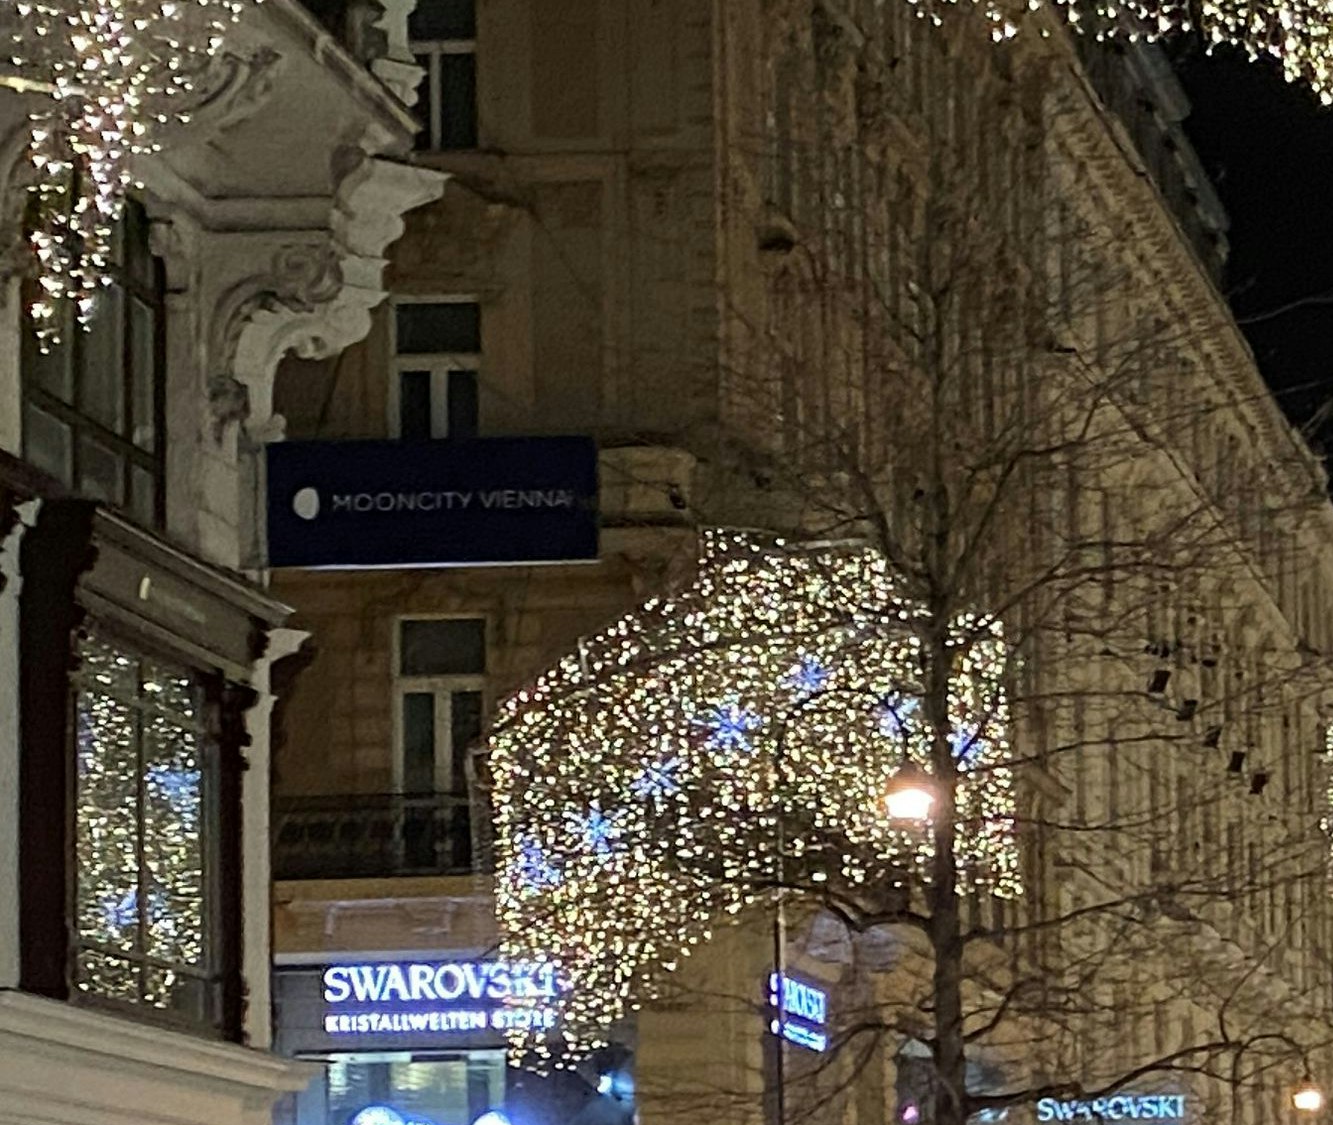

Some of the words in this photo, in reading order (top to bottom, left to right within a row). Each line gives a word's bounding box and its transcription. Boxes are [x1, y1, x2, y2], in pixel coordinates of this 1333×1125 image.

[331, 491, 473, 512] MOONCITY
[479, 488, 573, 509] VIENNA
[323, 962, 557, 1002] SWAROVSKI
[324, 1011, 487, 1033] KRISTALLWELTEN
[491, 1008, 557, 1029] STORE
